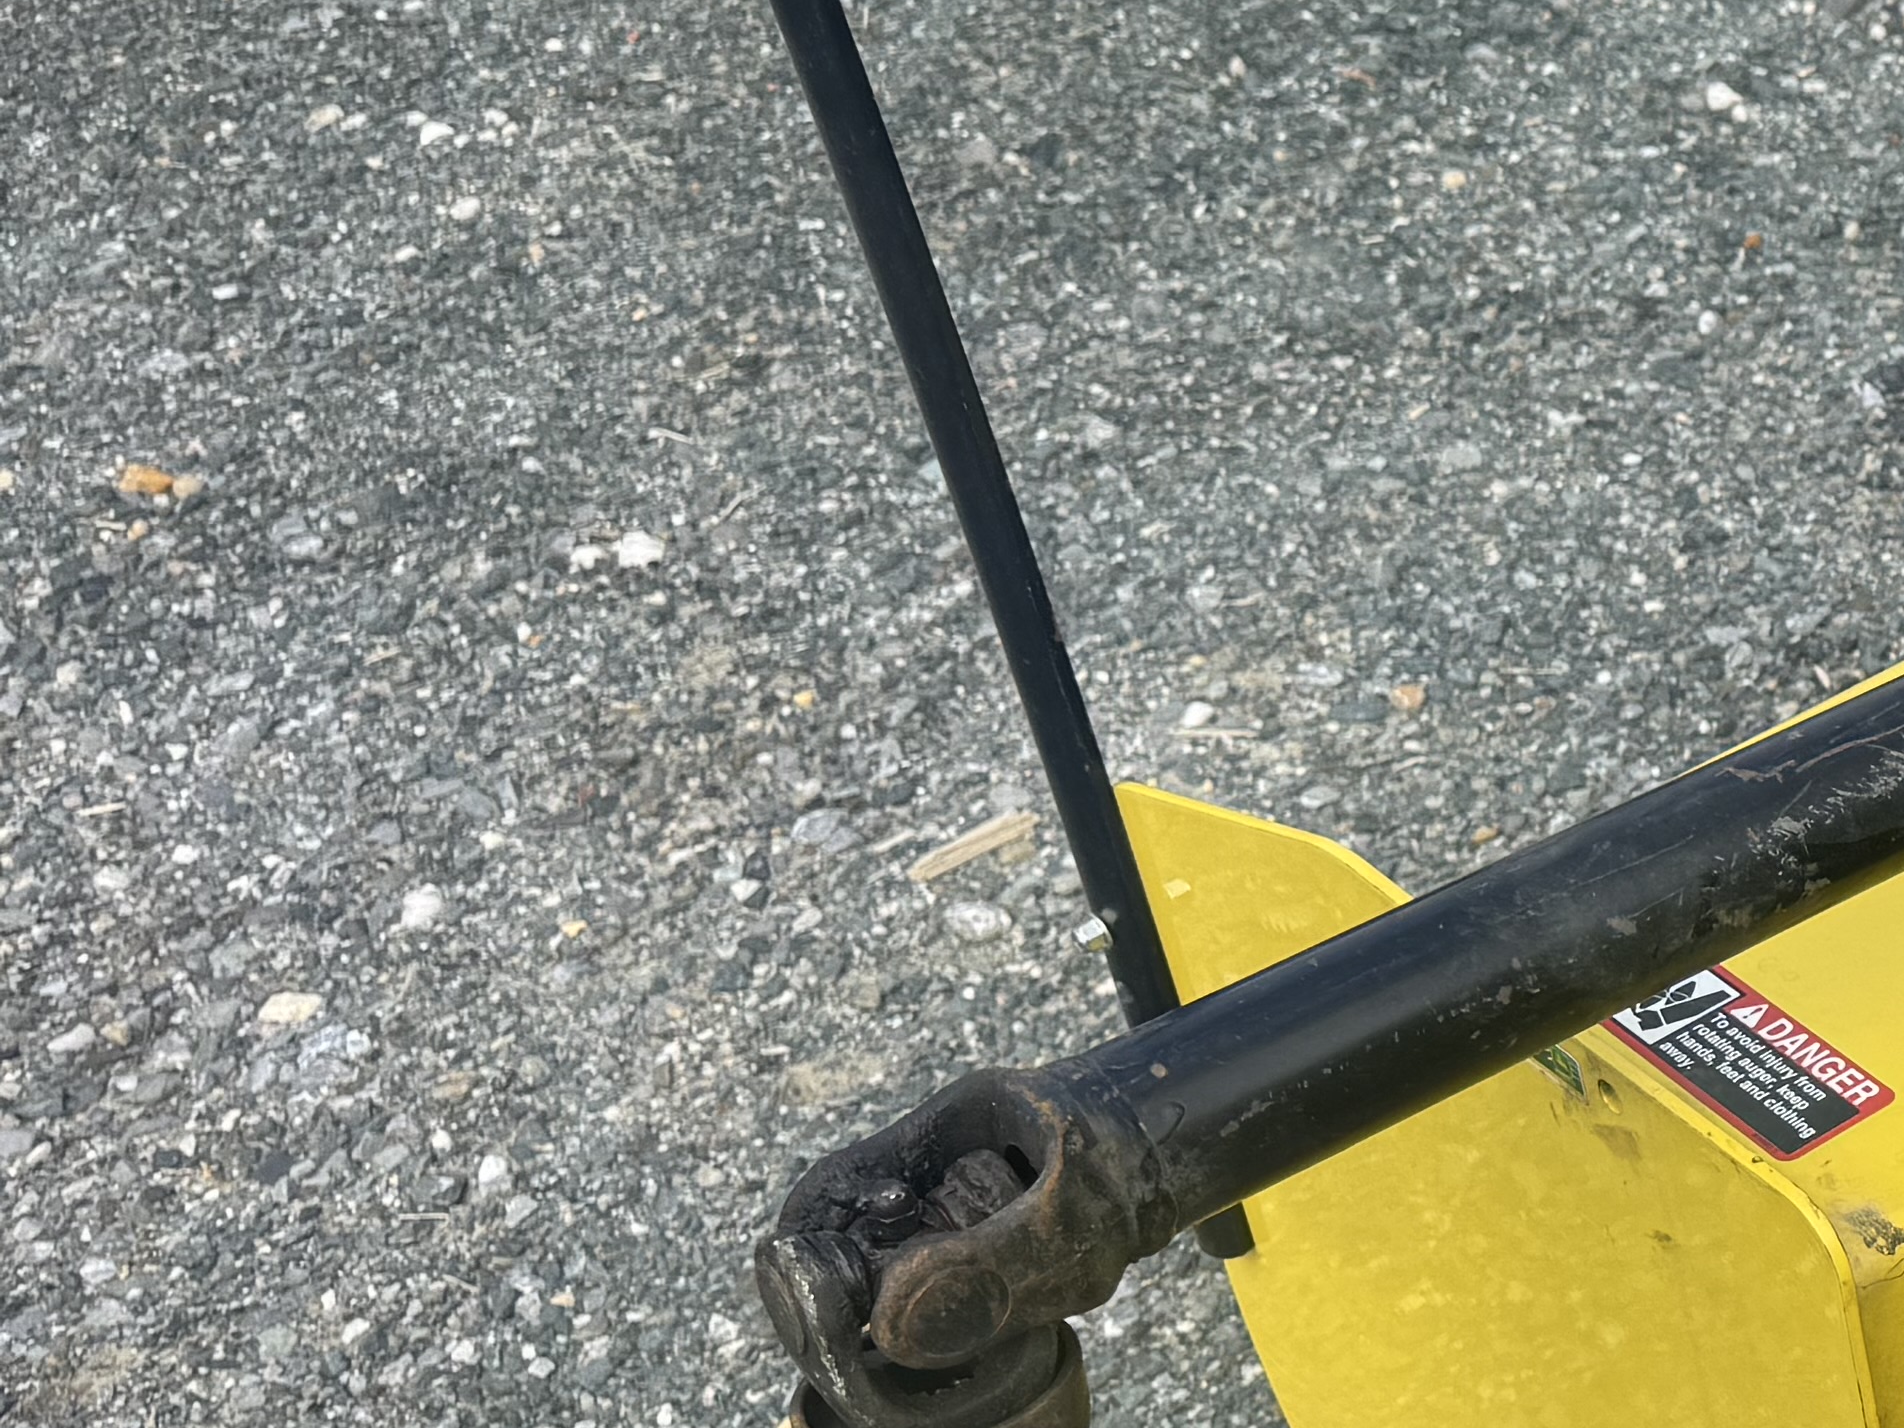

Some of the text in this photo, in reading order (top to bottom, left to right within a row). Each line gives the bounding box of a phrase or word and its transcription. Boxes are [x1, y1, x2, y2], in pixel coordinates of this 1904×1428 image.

[1659, 1042, 1695, 1070] away.
[1676, 1031, 1816, 1140] hands, feet and clothing
[1692, 1023, 1810, 1111] rotating auger, keep
[1710, 1012, 1827, 1101] To avoid injury from
[1757, 1017, 1880, 1106] DANGER
